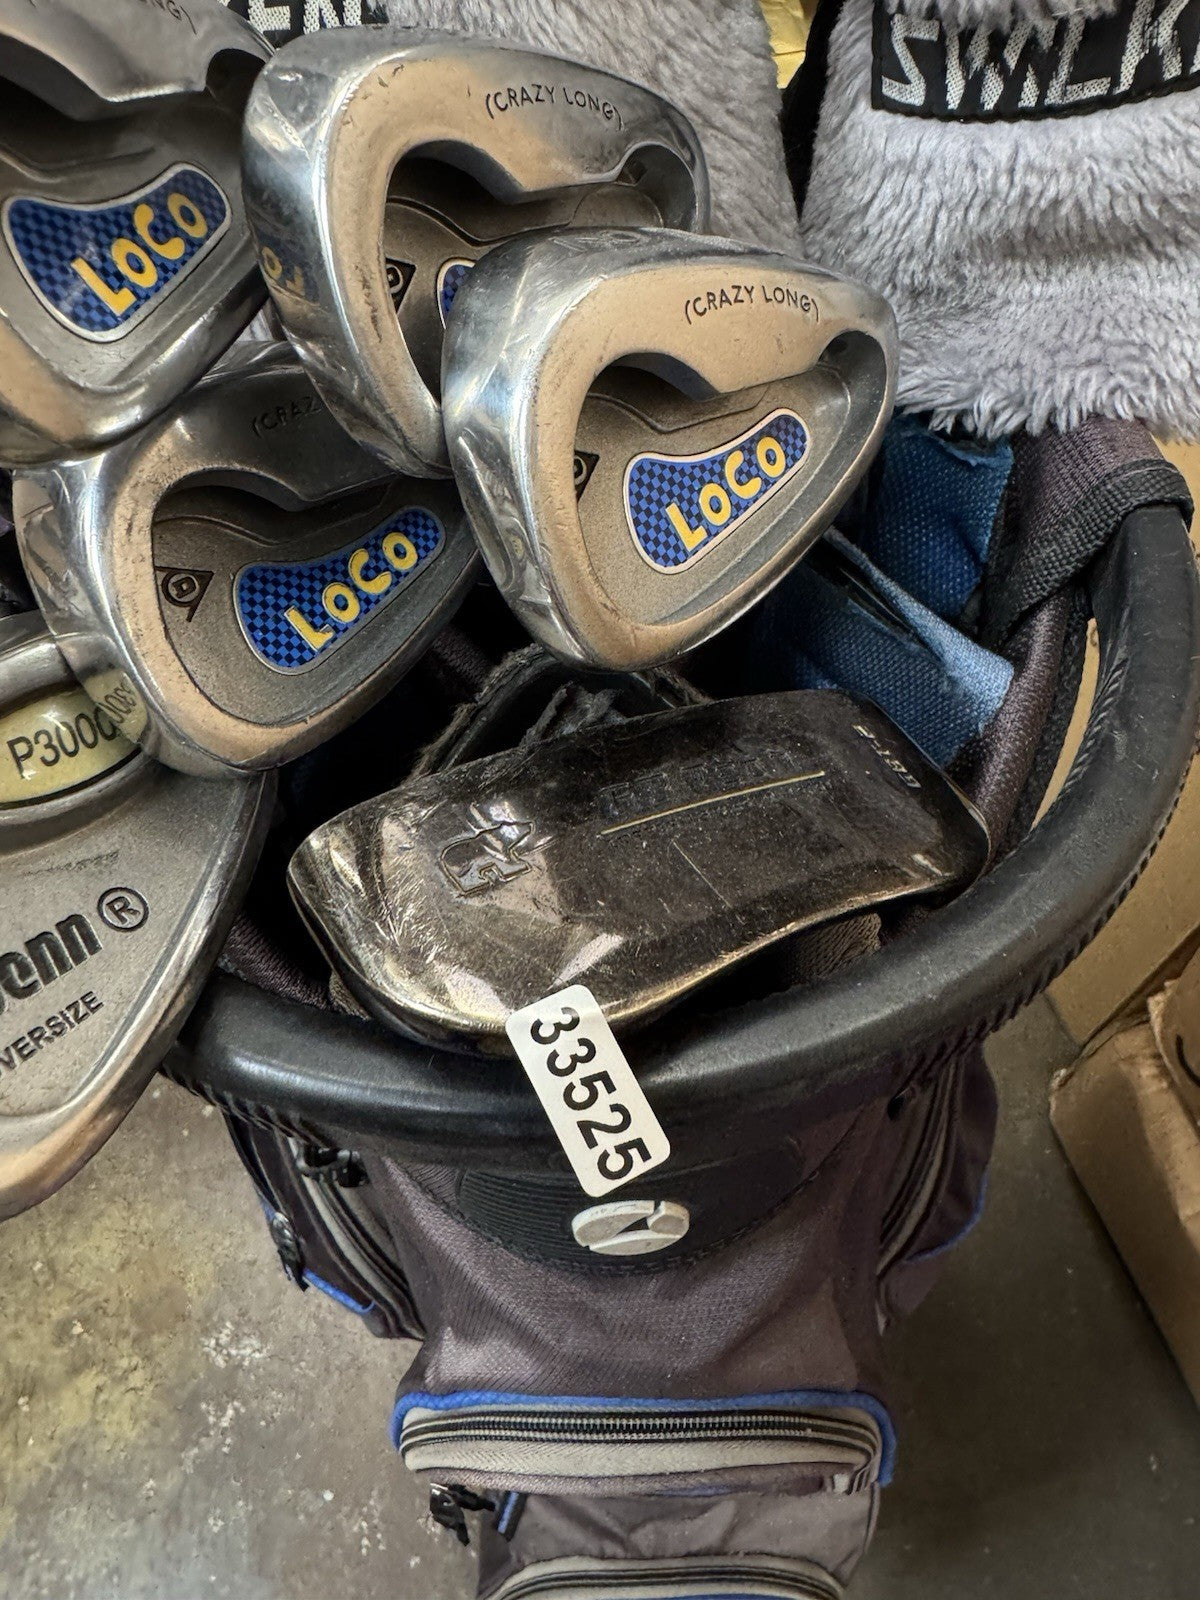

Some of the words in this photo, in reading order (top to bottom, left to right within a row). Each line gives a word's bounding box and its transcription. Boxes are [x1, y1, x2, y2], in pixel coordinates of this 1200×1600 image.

[485, 83, 555, 120] (CRAZY
[562, 86, 624, 131] LONG)
[71, 191, 209, 318] LOCO
[684, 284, 755, 325] (CRAZY
[761, 285, 820, 323] LONG)
[665, 435, 787, 552] LOCO
[284, 531, 419, 652] LOCO
[0, 990, 105, 1077] VERSIZE
[530, 1006, 652, 1181] 33525
